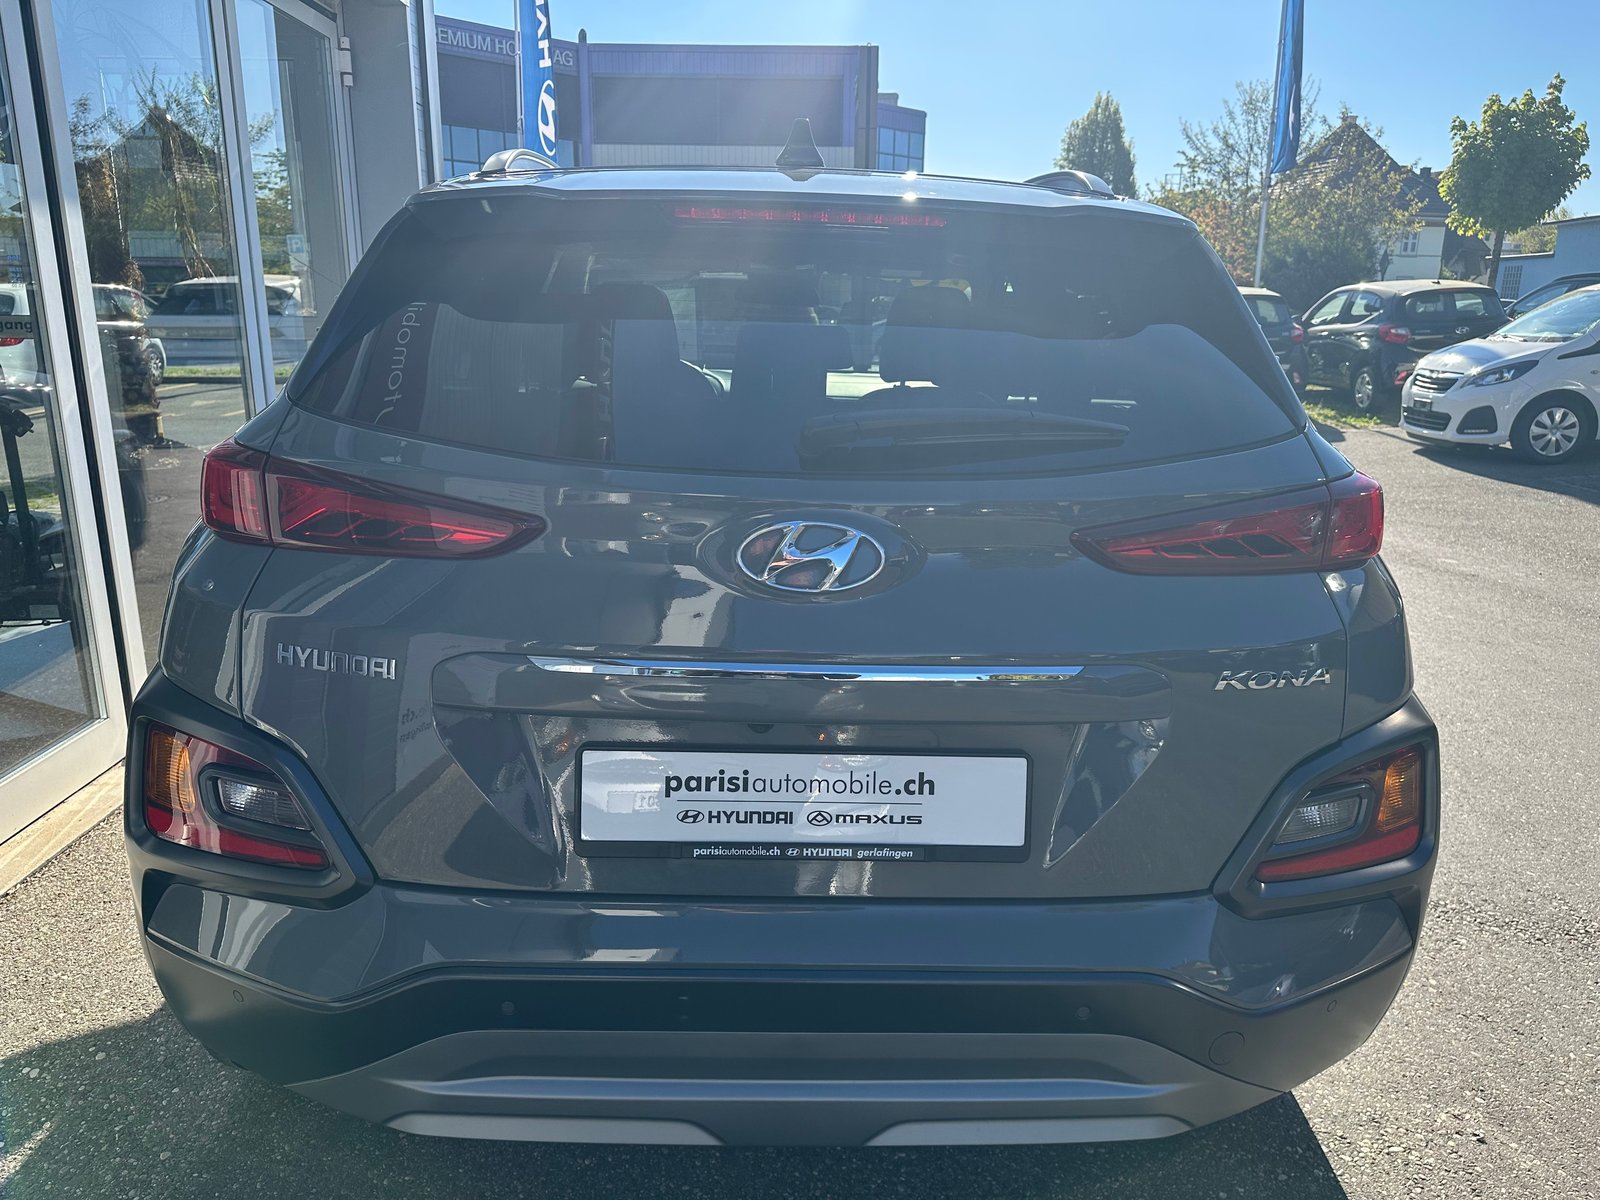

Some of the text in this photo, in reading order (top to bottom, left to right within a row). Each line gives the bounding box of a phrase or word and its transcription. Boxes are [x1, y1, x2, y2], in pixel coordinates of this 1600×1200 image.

[436, 27, 491, 52] EMIUM
[553, 50, 574, 66] AG
[535, 0, 552, 68] HY
[277, 642, 396, 680] HYUNDAI
[1214, 667, 1331, 691] KONA
[664, 769, 936, 798] parisiautomobile.ch
[707, 810, 793, 825] HYUNDAI
[835, 813, 923, 825] MAXUS
[693, 845, 913, 859] parisiautomobile.ch HYUNDAI gerlafingen
